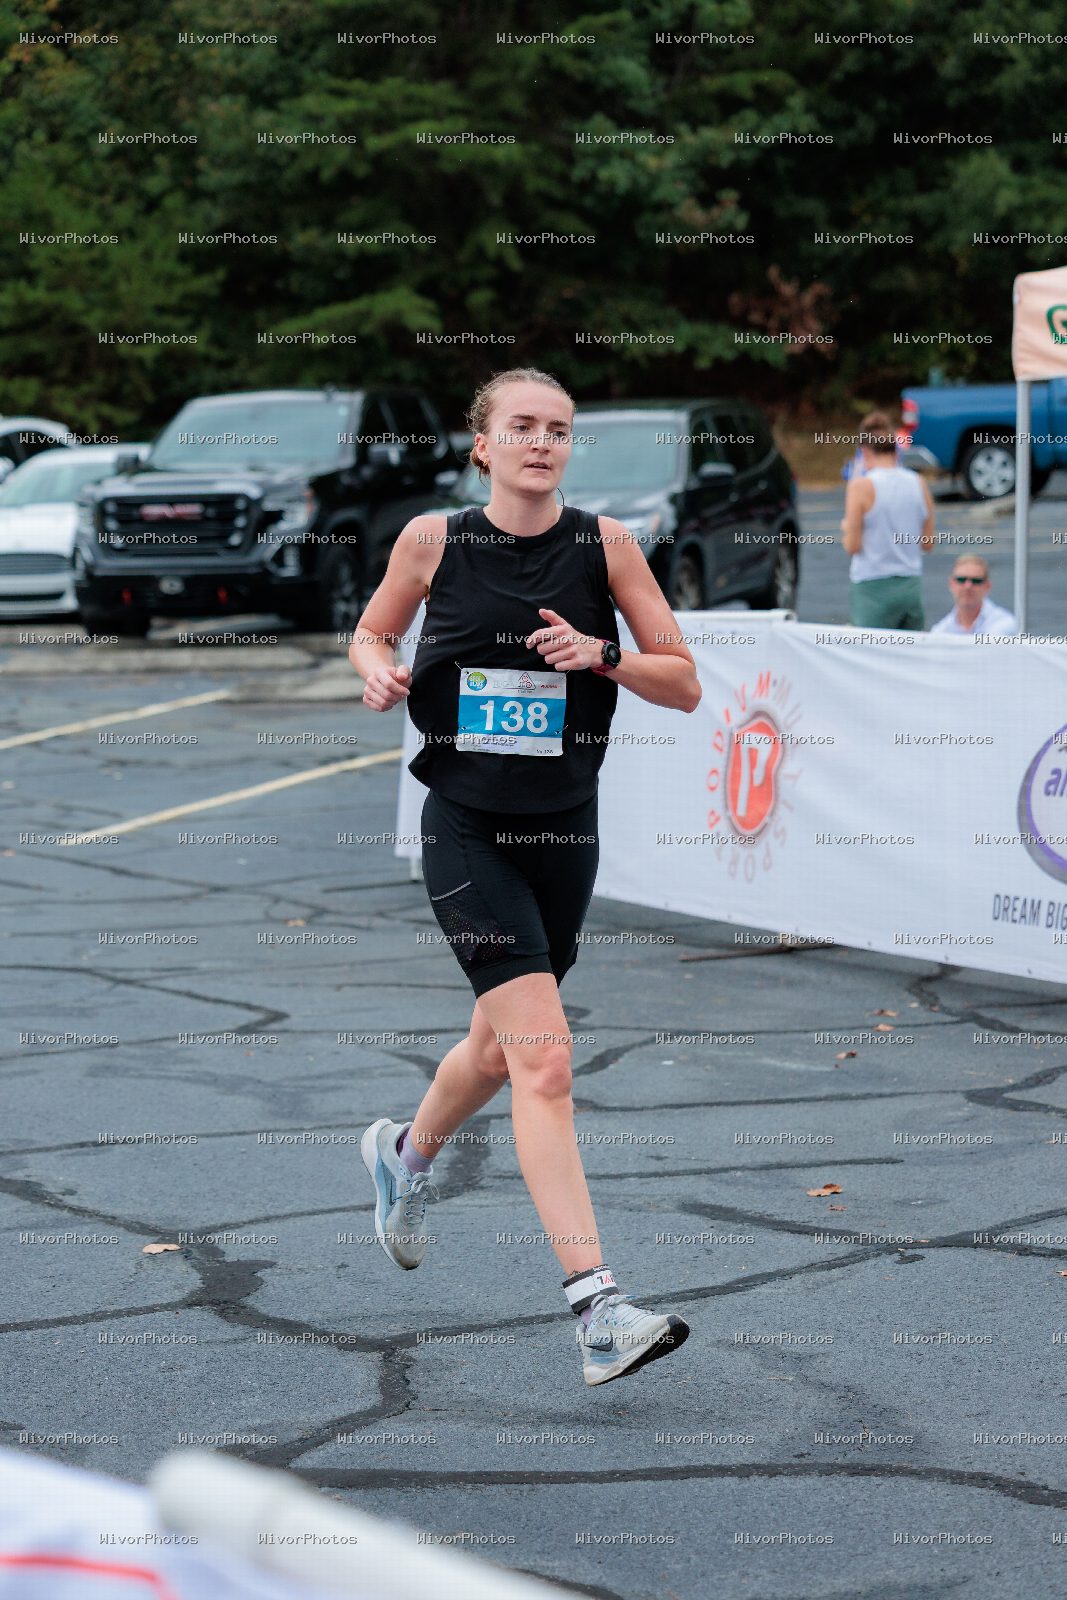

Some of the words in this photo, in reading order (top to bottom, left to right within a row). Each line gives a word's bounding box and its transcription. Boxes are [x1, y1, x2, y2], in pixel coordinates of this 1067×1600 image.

[480, 700, 548, 733] 138
[992, 893, 1041, 927] DREAM
[1045, 901, 1067, 931] BIG
